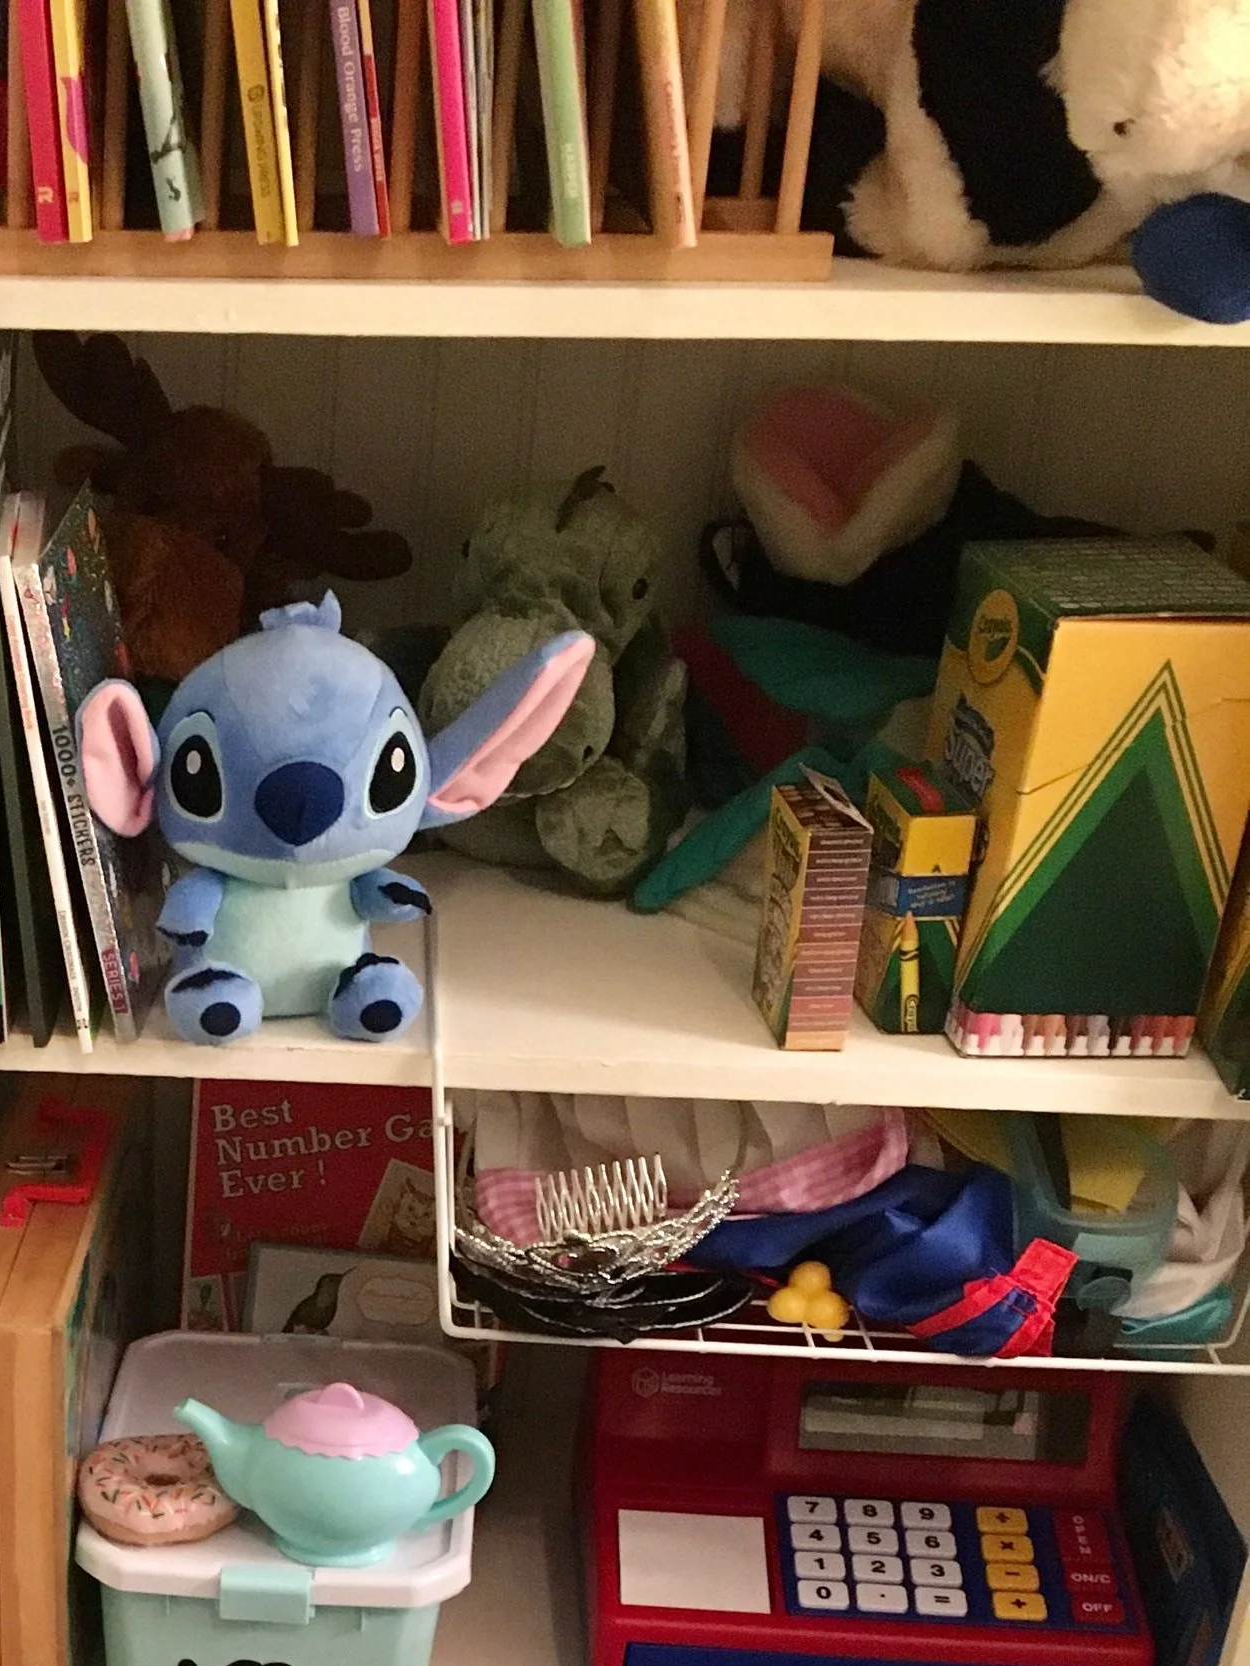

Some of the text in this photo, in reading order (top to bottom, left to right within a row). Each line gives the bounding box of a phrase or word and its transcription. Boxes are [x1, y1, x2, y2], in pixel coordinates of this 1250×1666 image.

[337, 6, 364, 173] Blood Orange Press
[52, 724, 96, 868] 1000+ STICKERS
[102, 951, 124, 1002] SERIES
[211, 1099, 294, 1133] Best
[216, 1113, 434, 1166] Number Ga
[219, 1168, 306, 1199] Ever
[805, 1501, 819, 1514] 7
[862, 1504, 878, 1518] 8
[919, 1507, 934, 1521] 9
[808, 1529, 824, 1542] 4
[866, 1532, 882, 1545] 5
[925, 1535, 940, 1549] 6
[814, 1557, 825, 1570] 1
[871, 1561, 886, 1574] 2
[930, 1564, 945, 1578] 3
[1070, 1572, 1111, 1585] ON/C
[816, 1586, 832, 1600] 0
[1081, 1601, 1114, 1614] OFF
